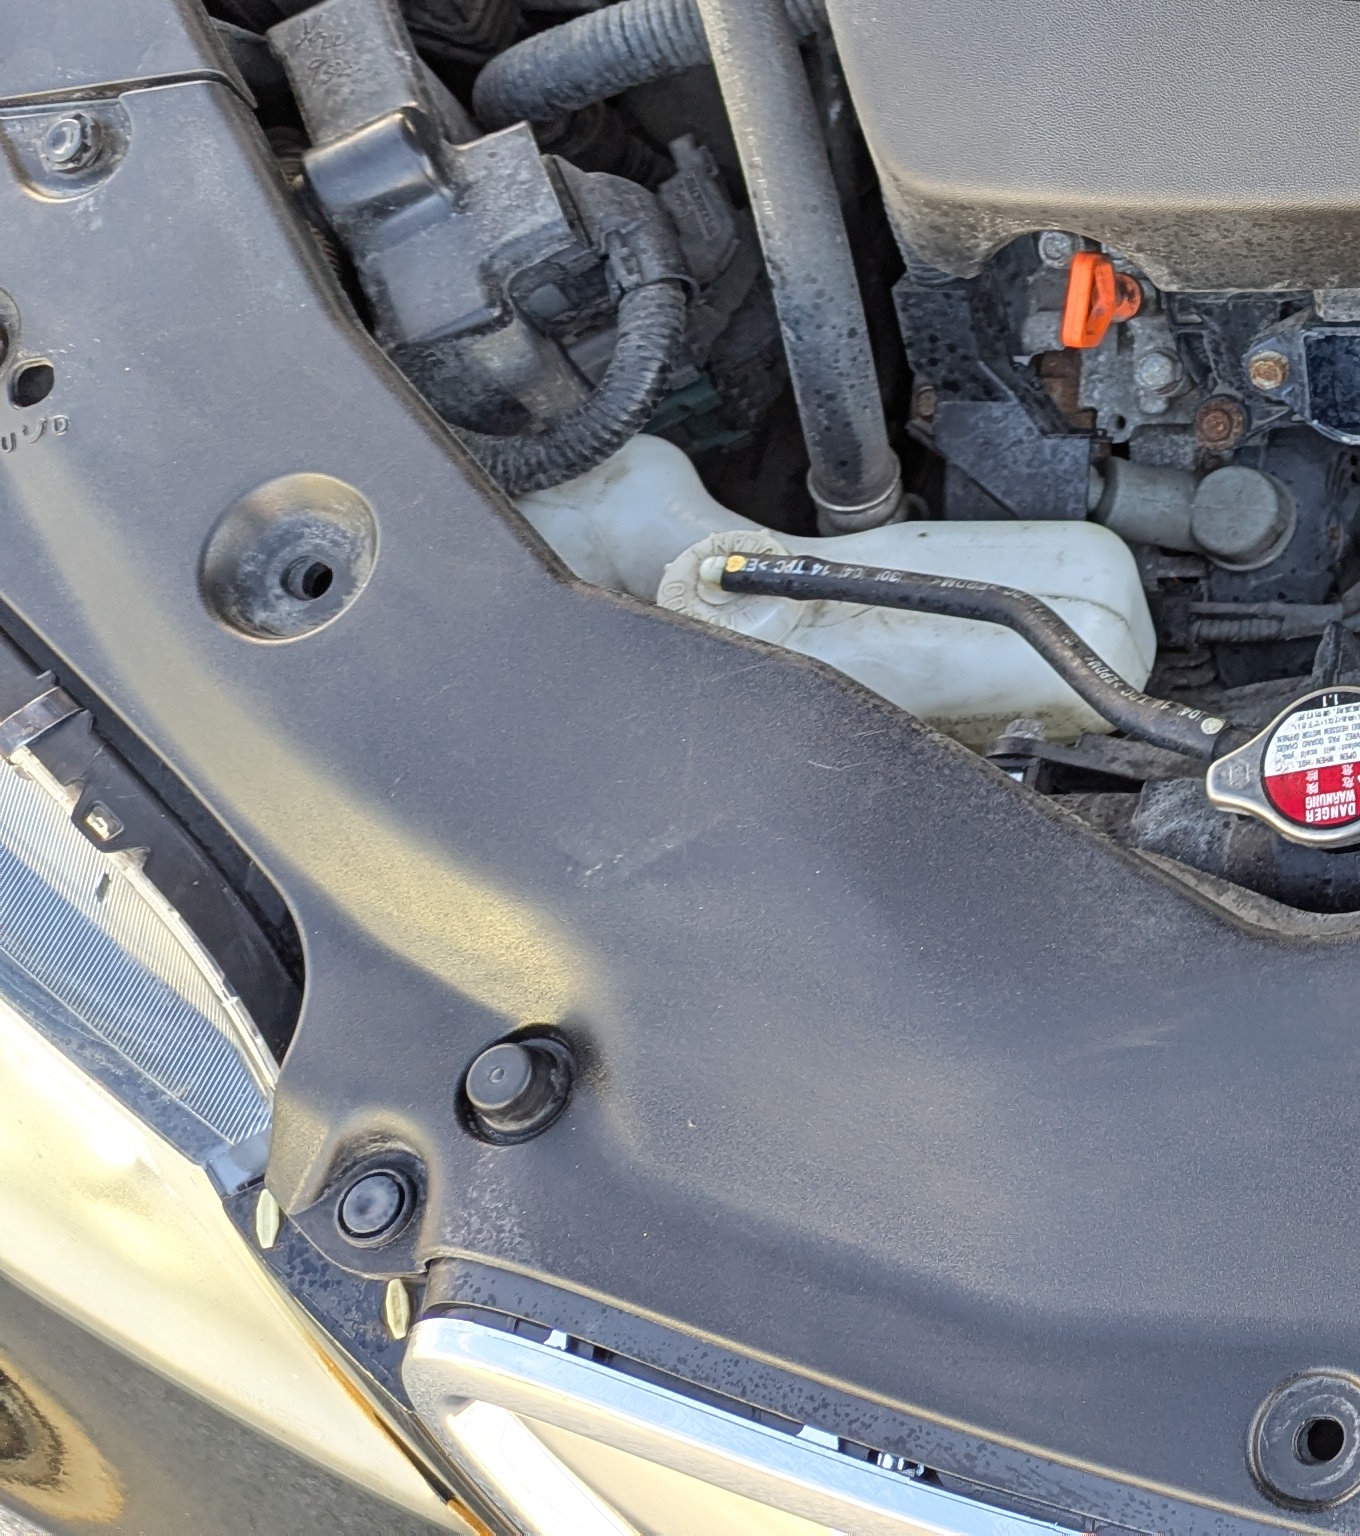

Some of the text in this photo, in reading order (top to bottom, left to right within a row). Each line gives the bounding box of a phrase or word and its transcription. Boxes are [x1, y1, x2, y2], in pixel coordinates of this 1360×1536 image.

[1322, 693, 1339, 708] 1.1
[1328, 735, 1340, 744] PAS
[1340, 751, 1357, 761] OPEN
[1304, 789, 1356, 808] WARNUNG
[1305, 802, 1356, 823] DANGER
